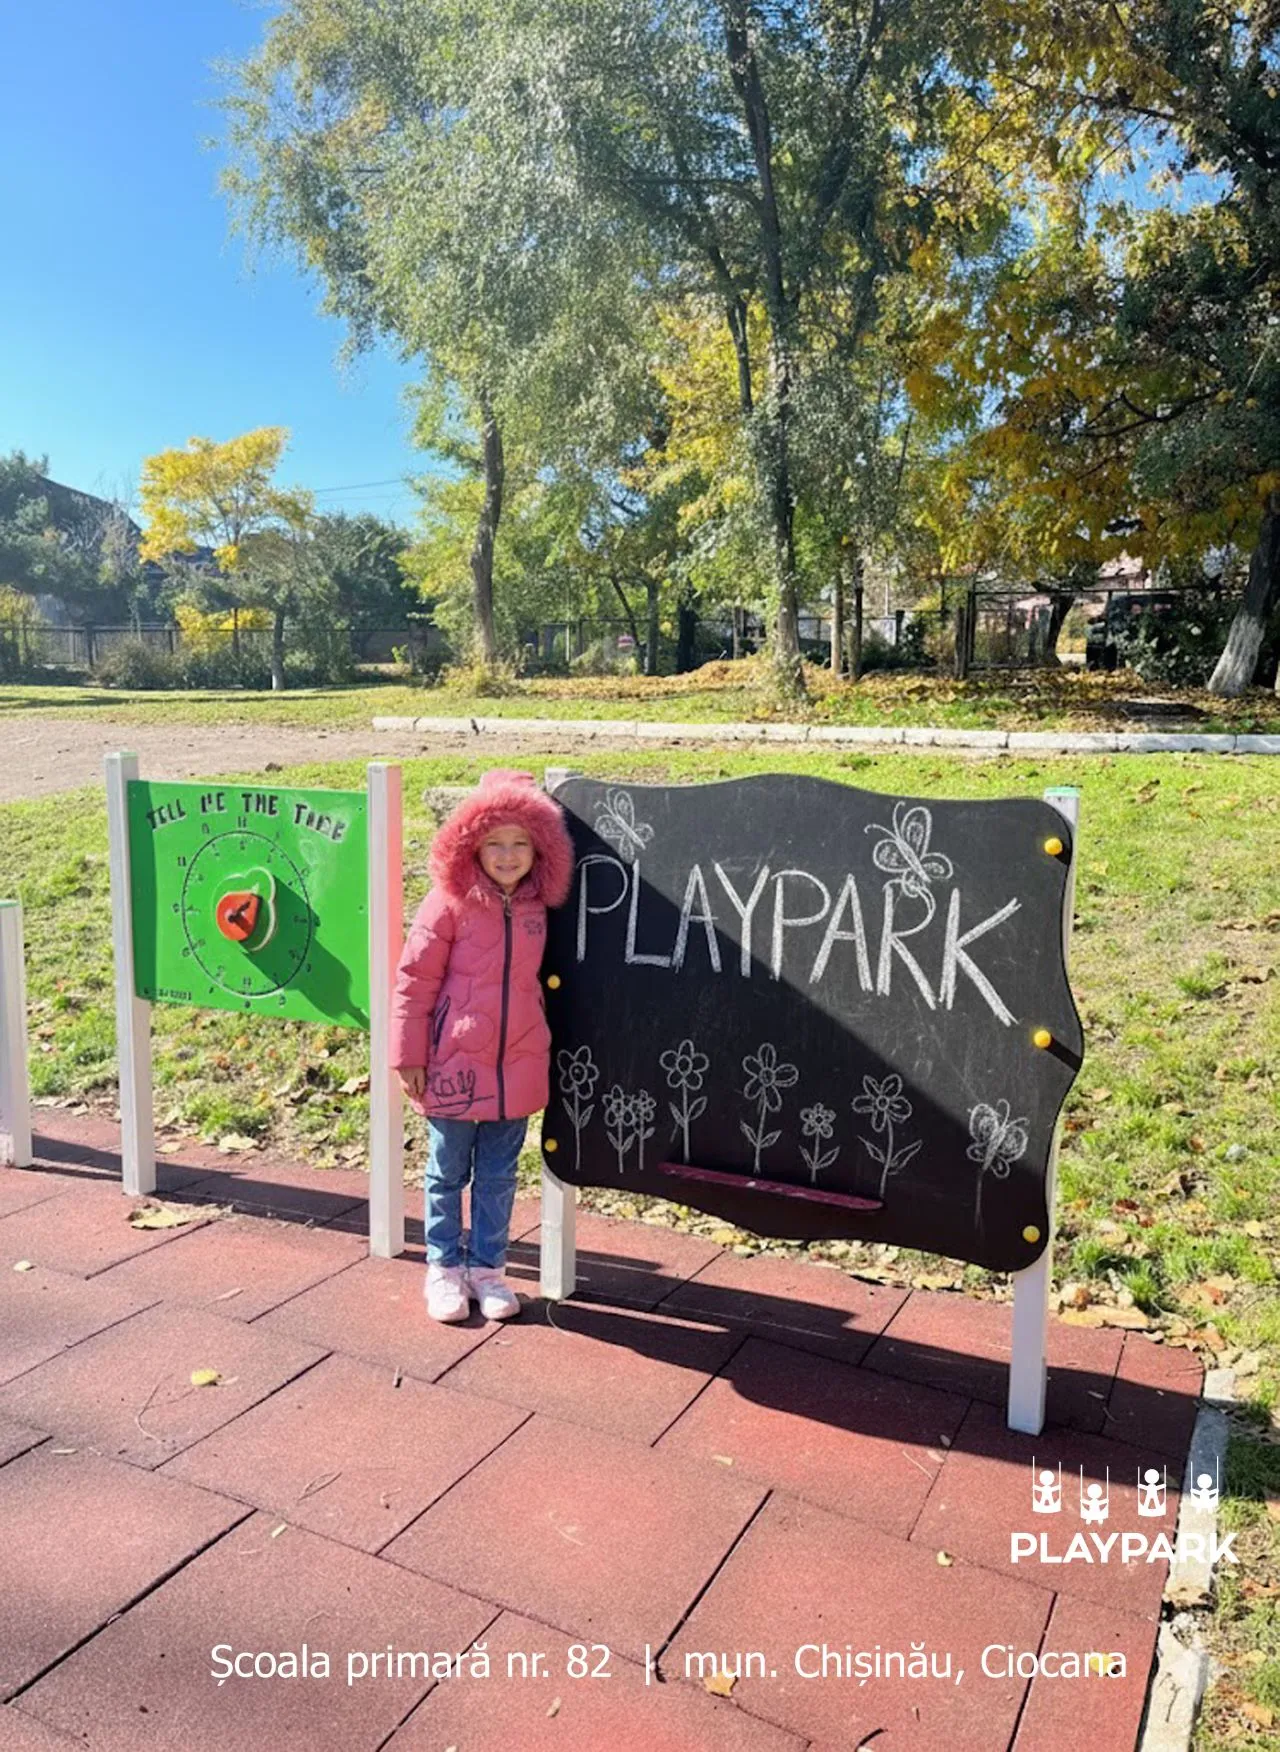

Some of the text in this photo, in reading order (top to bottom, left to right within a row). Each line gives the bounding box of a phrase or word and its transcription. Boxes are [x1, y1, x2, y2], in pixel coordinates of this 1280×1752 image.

[146, 798, 186, 830] TELL
[241, 793, 279, 816] THE
[576, 853, 1022, 1028] PLAYPARK
